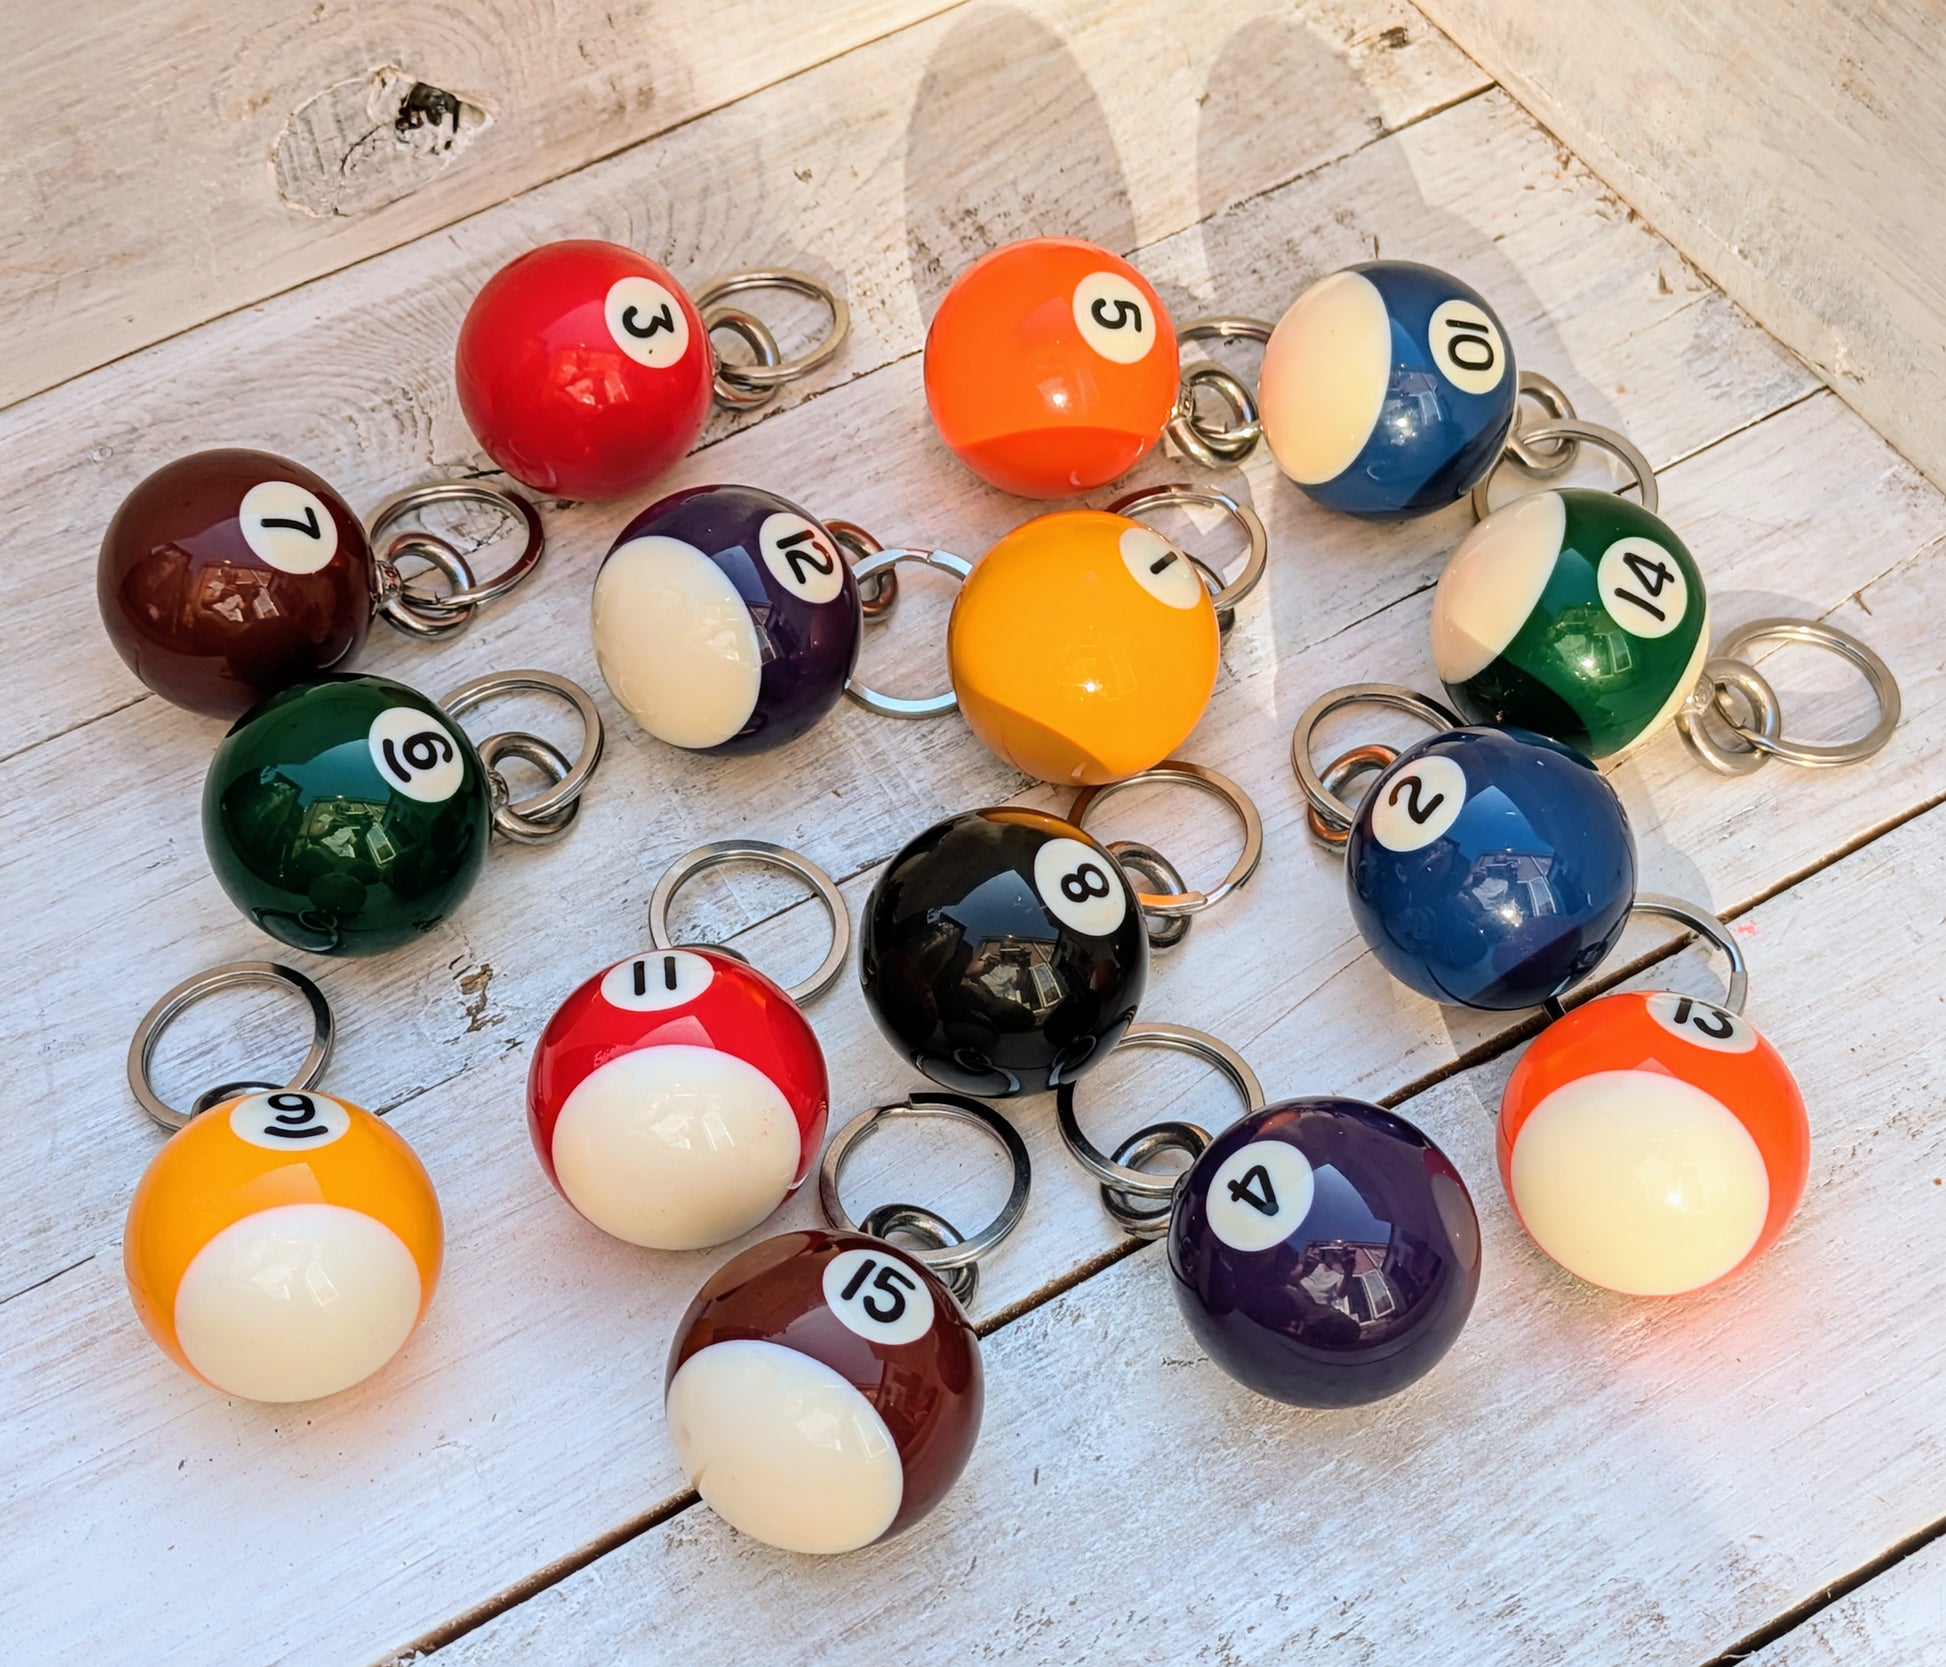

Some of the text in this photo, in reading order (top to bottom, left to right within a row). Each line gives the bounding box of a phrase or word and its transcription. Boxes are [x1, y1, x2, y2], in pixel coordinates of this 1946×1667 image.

[622, 303, 674, 338] 3
[1091, 298, 1141, 332] 5
[1445, 319, 1494, 371] 10
[261, 506, 321, 539] 7
[776, 530, 834, 584] 12
[1150, 551, 1177, 575] 1
[1614, 552, 1675, 622] 14
[382, 731, 453, 782] 6
[1388, 775, 1444, 824] 2
[1061, 862, 1109, 902] 8
[634, 956, 677, 995] 11
[1674, 998, 1733, 1038] 13
[264, 1093, 329, 1138] 9
[1227, 1165, 1279, 1216] 4
[841, 1259, 915, 1323] 15
